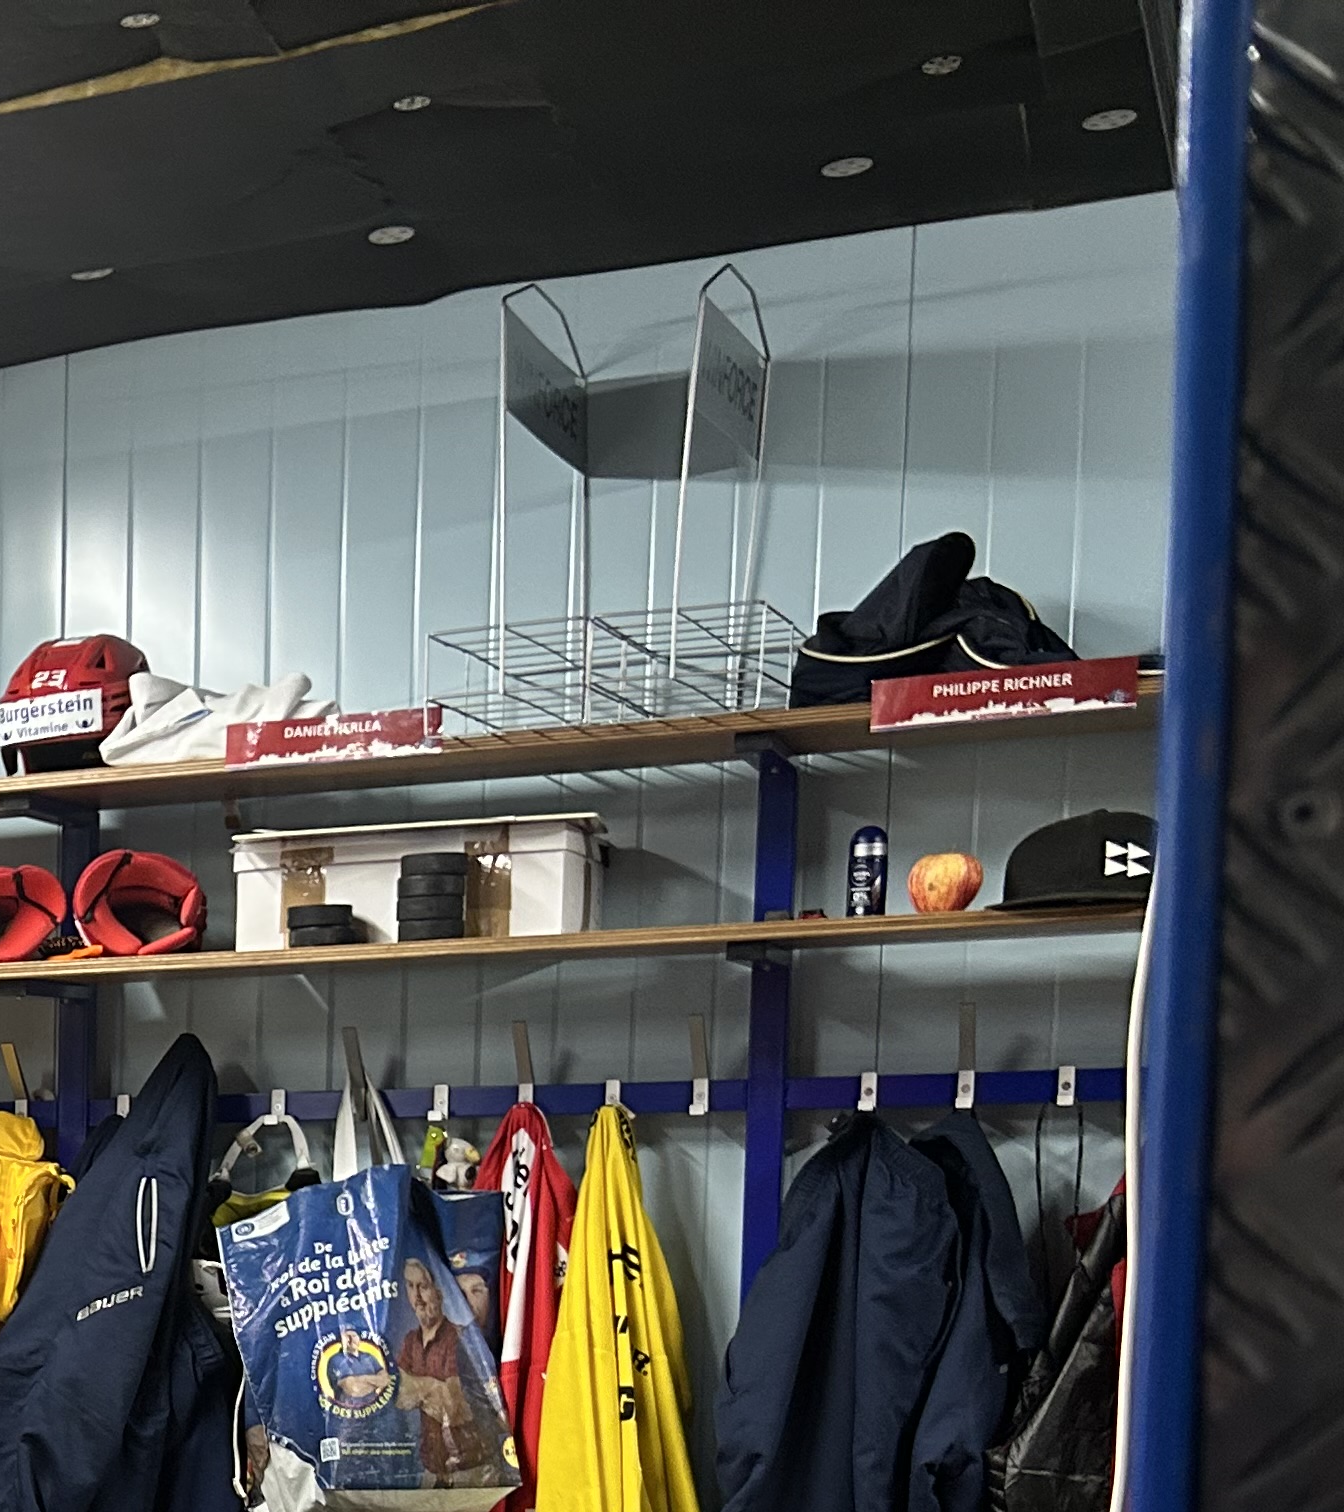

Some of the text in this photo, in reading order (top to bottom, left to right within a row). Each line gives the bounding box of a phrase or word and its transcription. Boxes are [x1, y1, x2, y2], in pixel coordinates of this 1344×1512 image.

[31, 669, 68, 690] 23
[933, 673, 1073, 699] PHILIPPE RICHNER
[0, 694, 94, 724] Burgerstein
[16, 721, 69, 739] Vitamine
[313, 1242, 333, 1255] De
[298, 1256, 322, 1274] de
[325, 1255, 345, 1269] la
[288, 1271, 331, 1301] Roi
[274, 1279, 399, 1339] suppléants
[332, 1405, 352, 1419] DES
